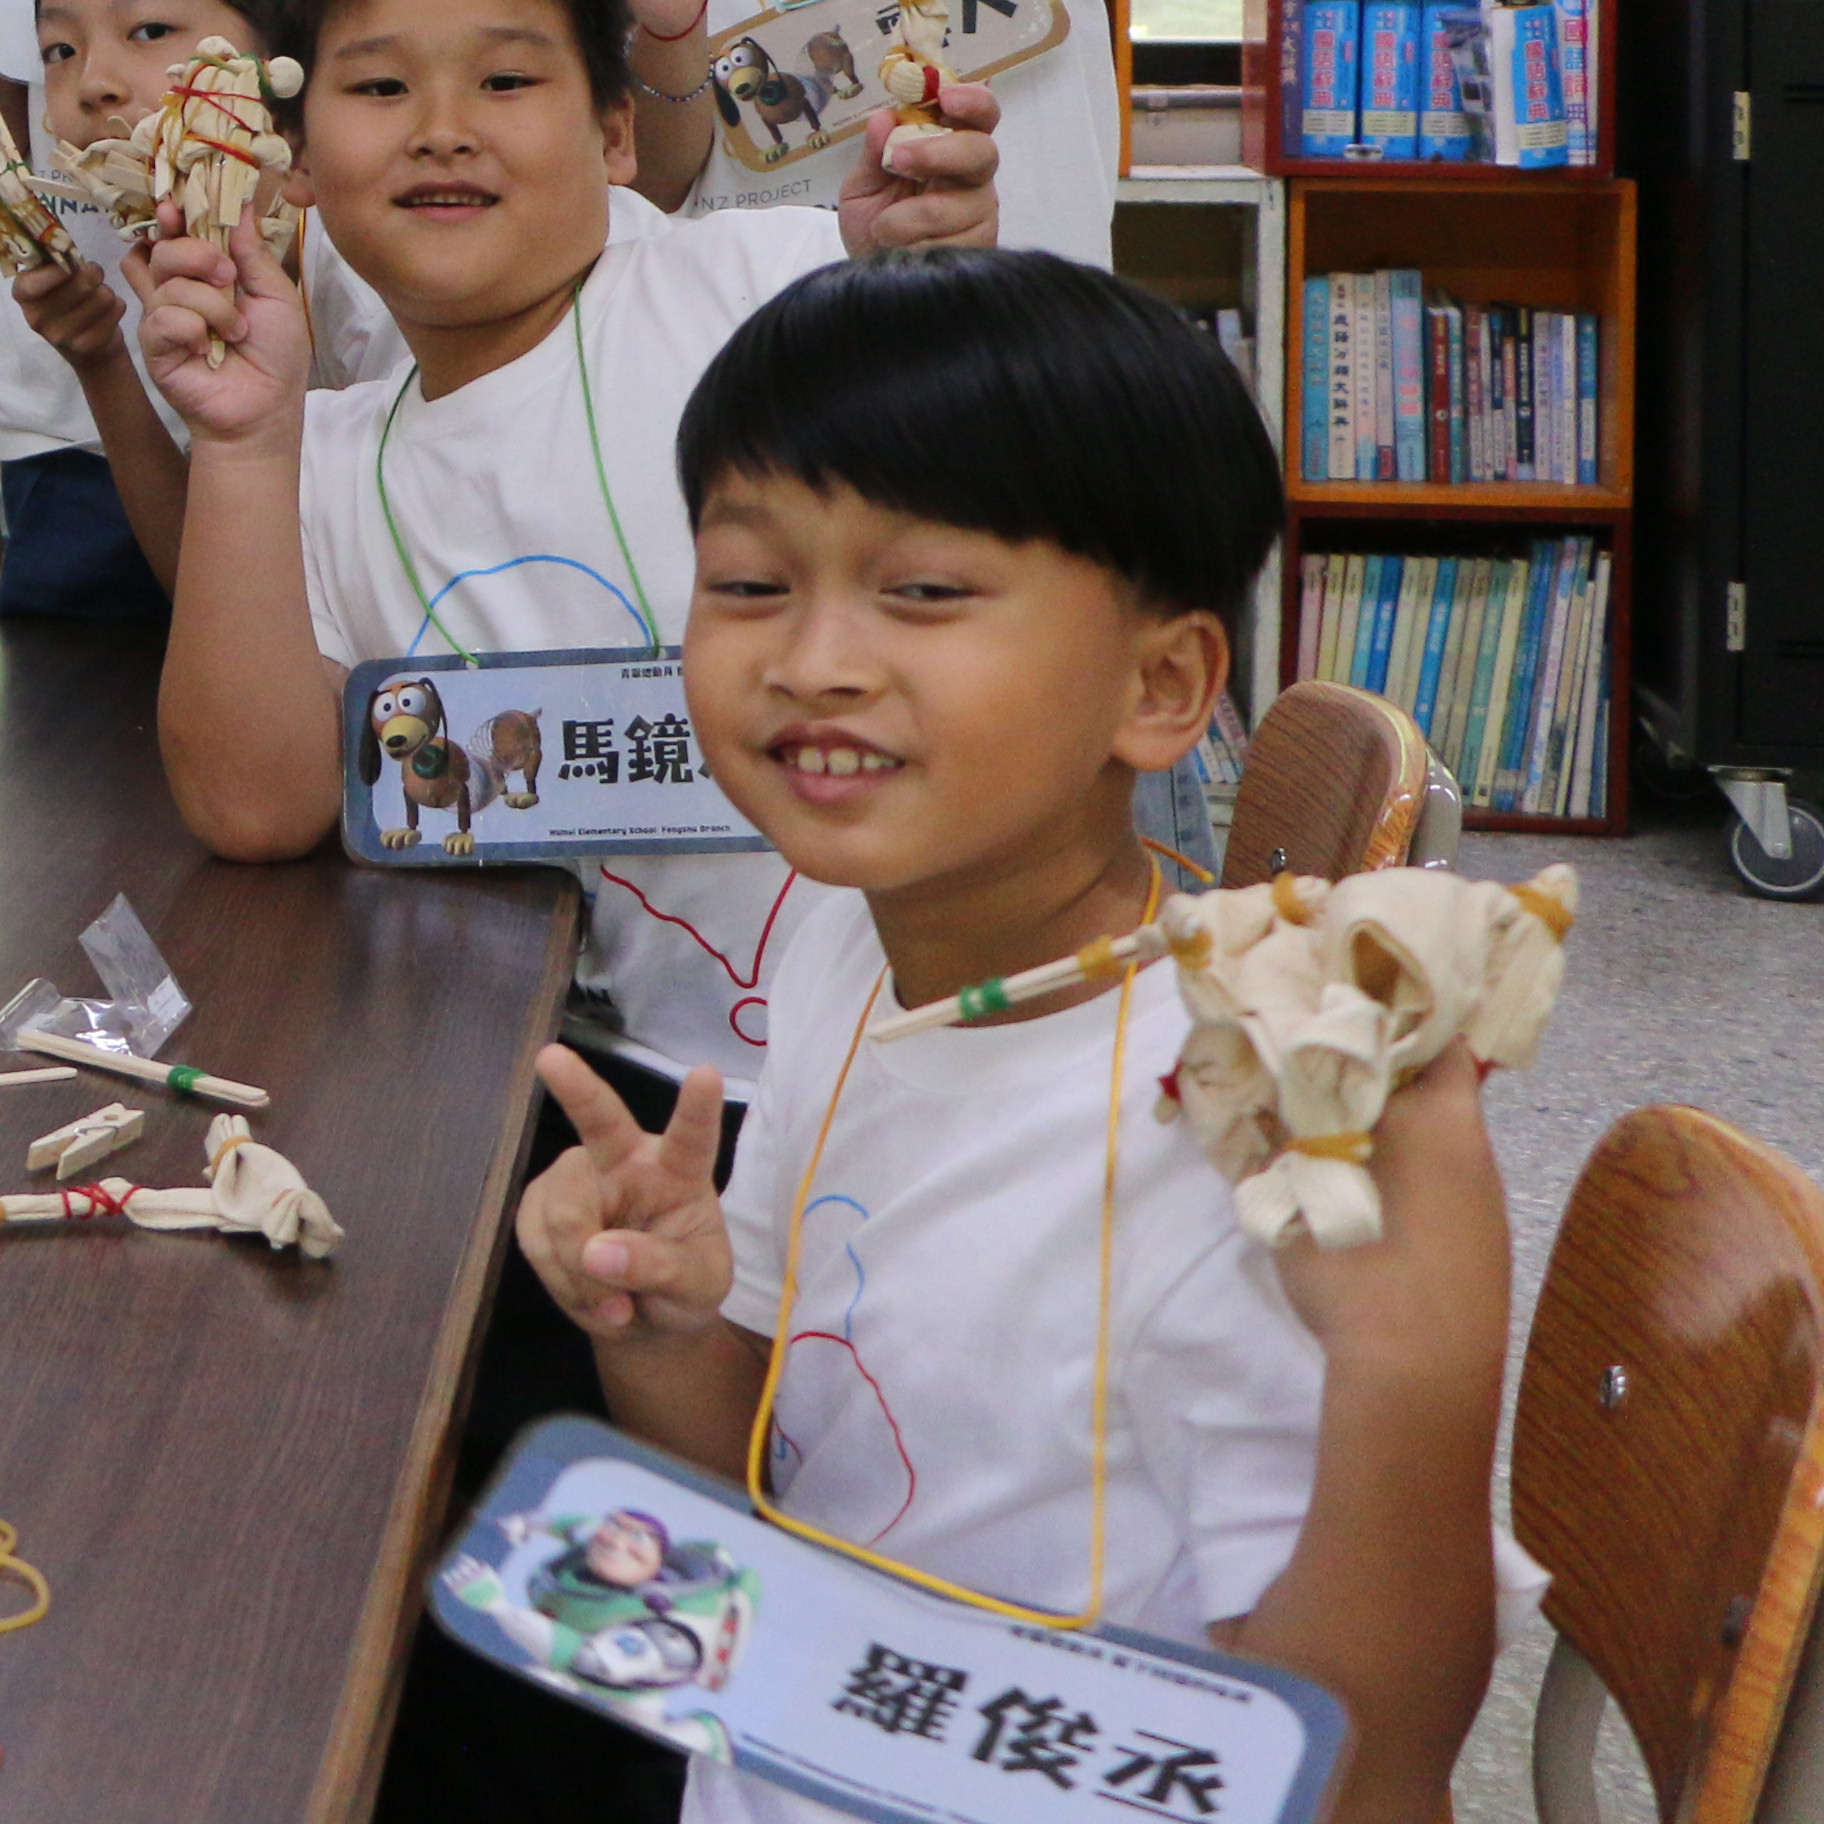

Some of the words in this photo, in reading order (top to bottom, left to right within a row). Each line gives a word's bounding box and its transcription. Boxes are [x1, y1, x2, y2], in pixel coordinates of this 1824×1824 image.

[736, 179, 812, 208] PROJECT
[557, 712, 712, 785] 馬鏡
[830, 1641, 1226, 1824] 羅俊丞
